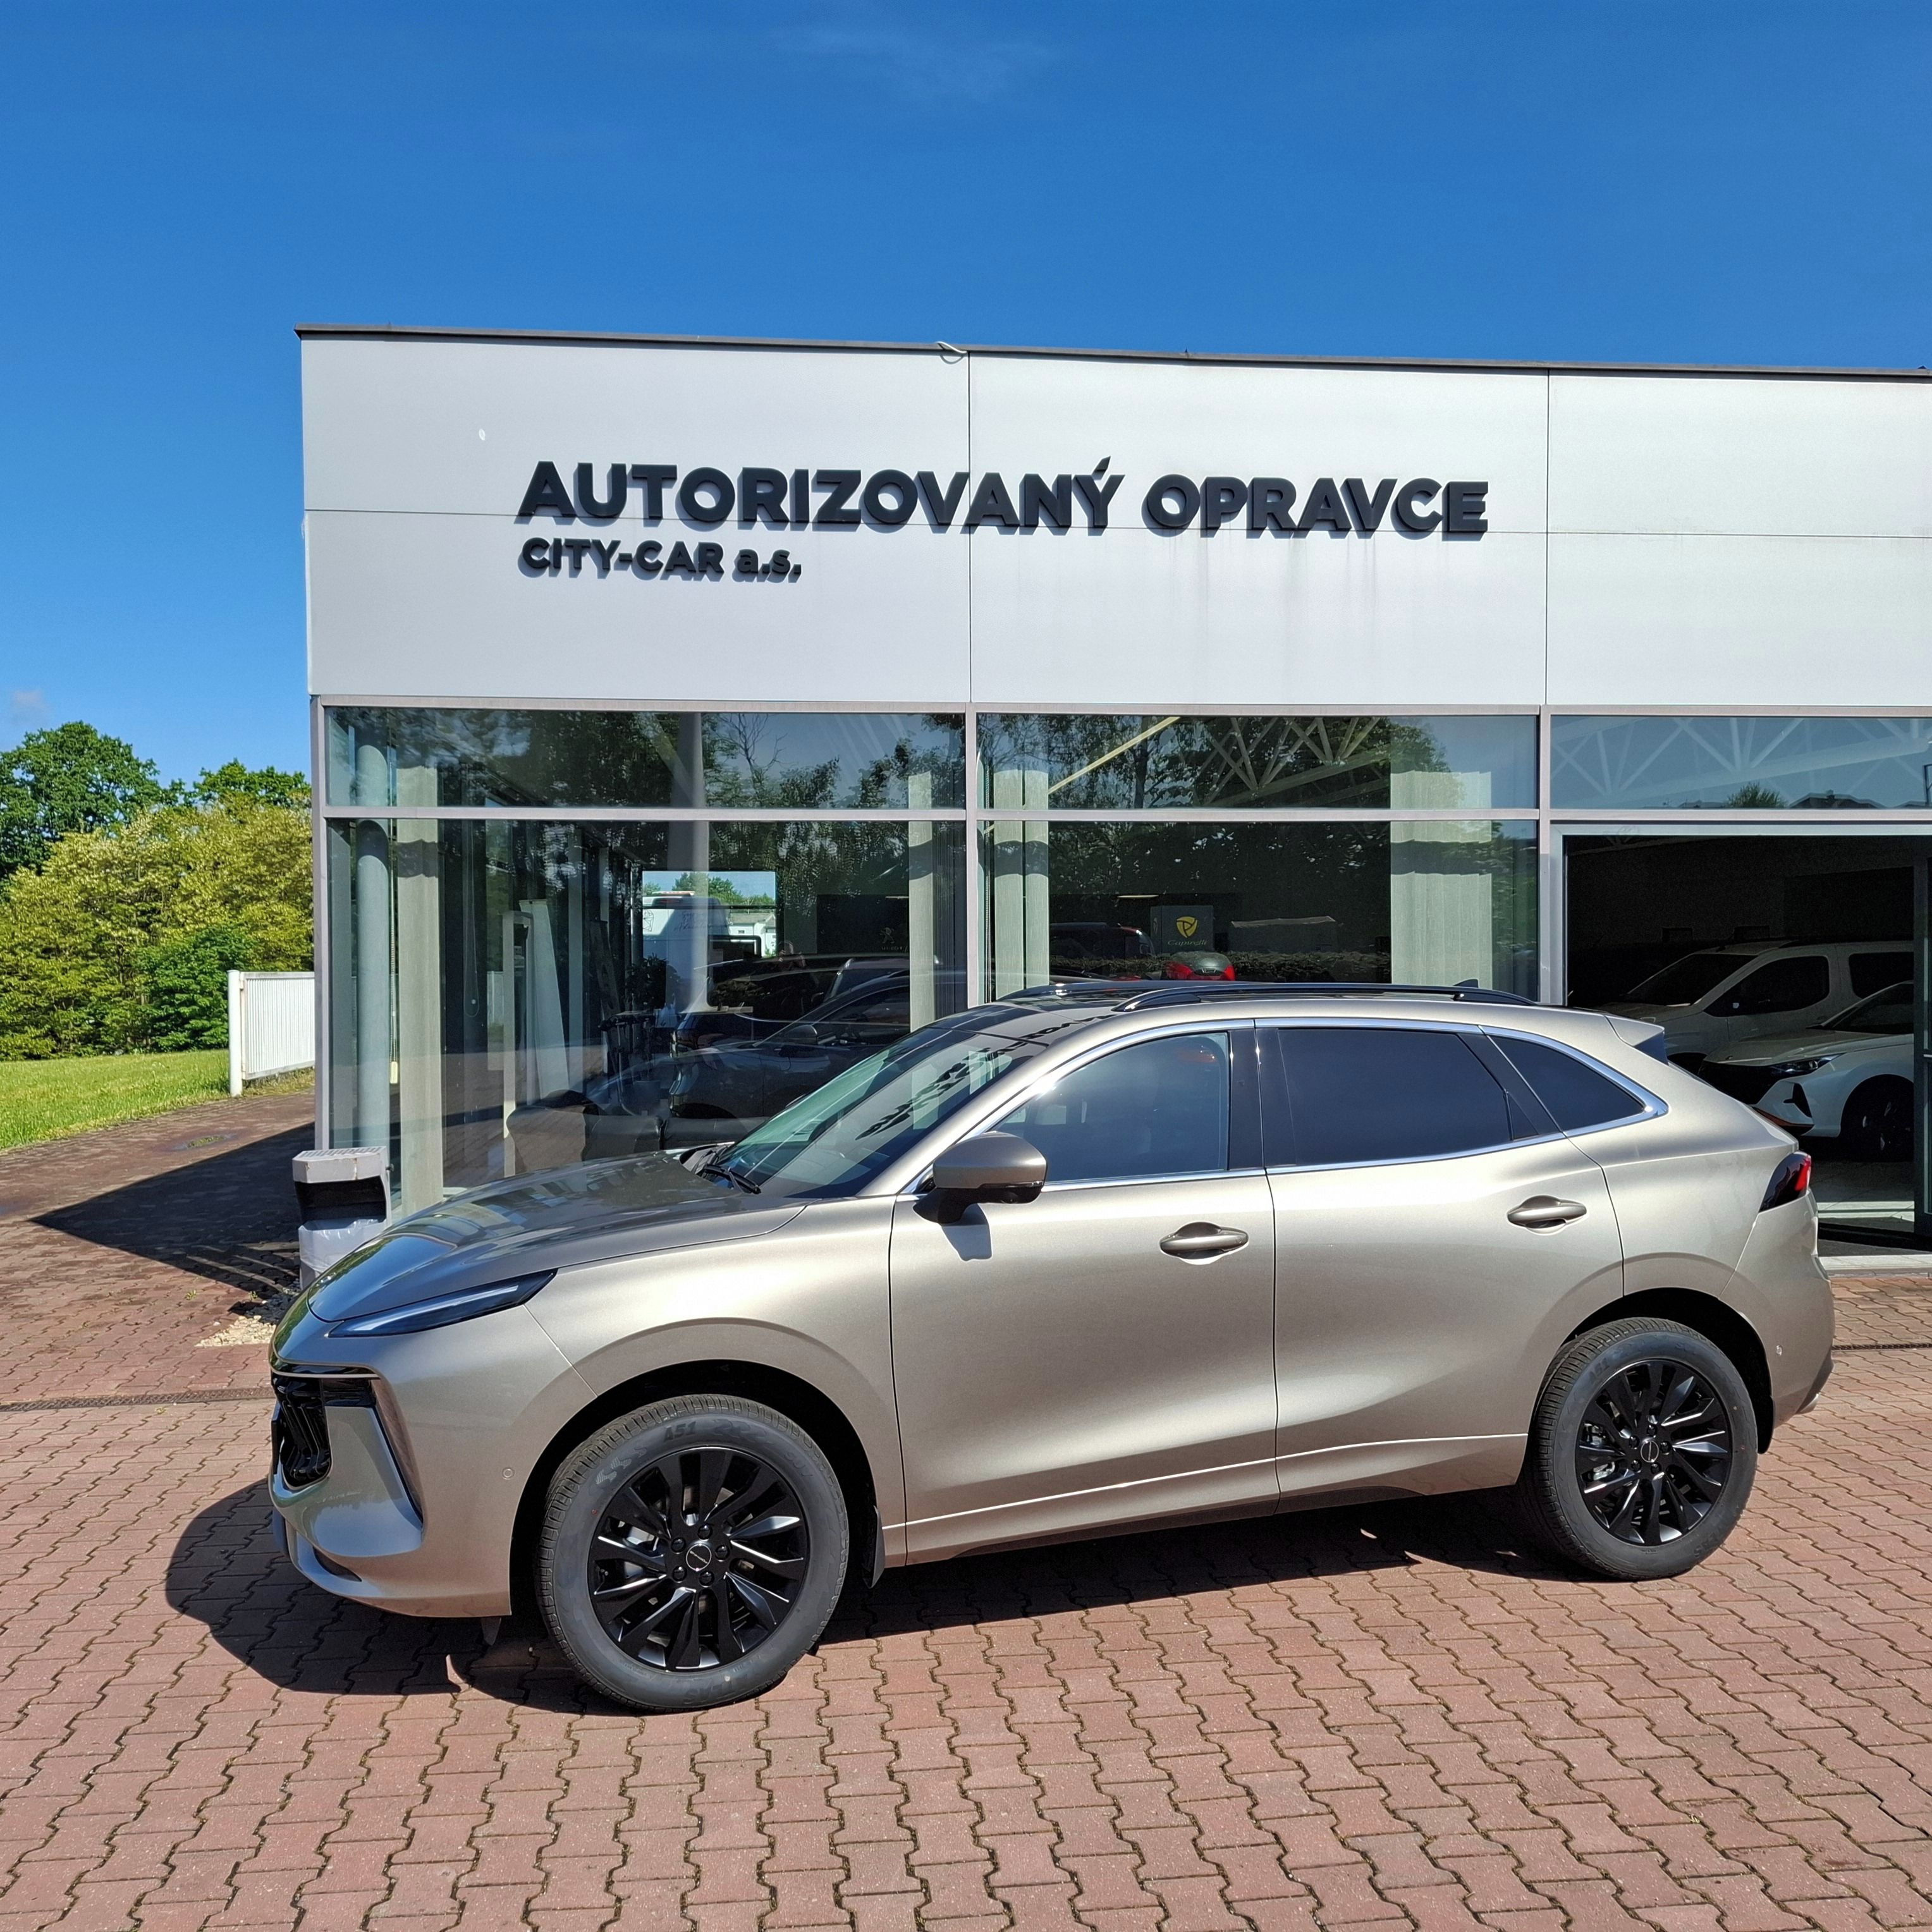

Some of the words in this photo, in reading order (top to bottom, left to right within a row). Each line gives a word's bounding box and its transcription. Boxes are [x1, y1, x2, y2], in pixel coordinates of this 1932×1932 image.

[516, 456, 1125, 530] AUTORIZOVANÝ
[1144, 474, 1488, 532] OPRAVCE
[522, 537, 724, 574] CITY-CAR
[739, 548, 802, 575] a.s.
